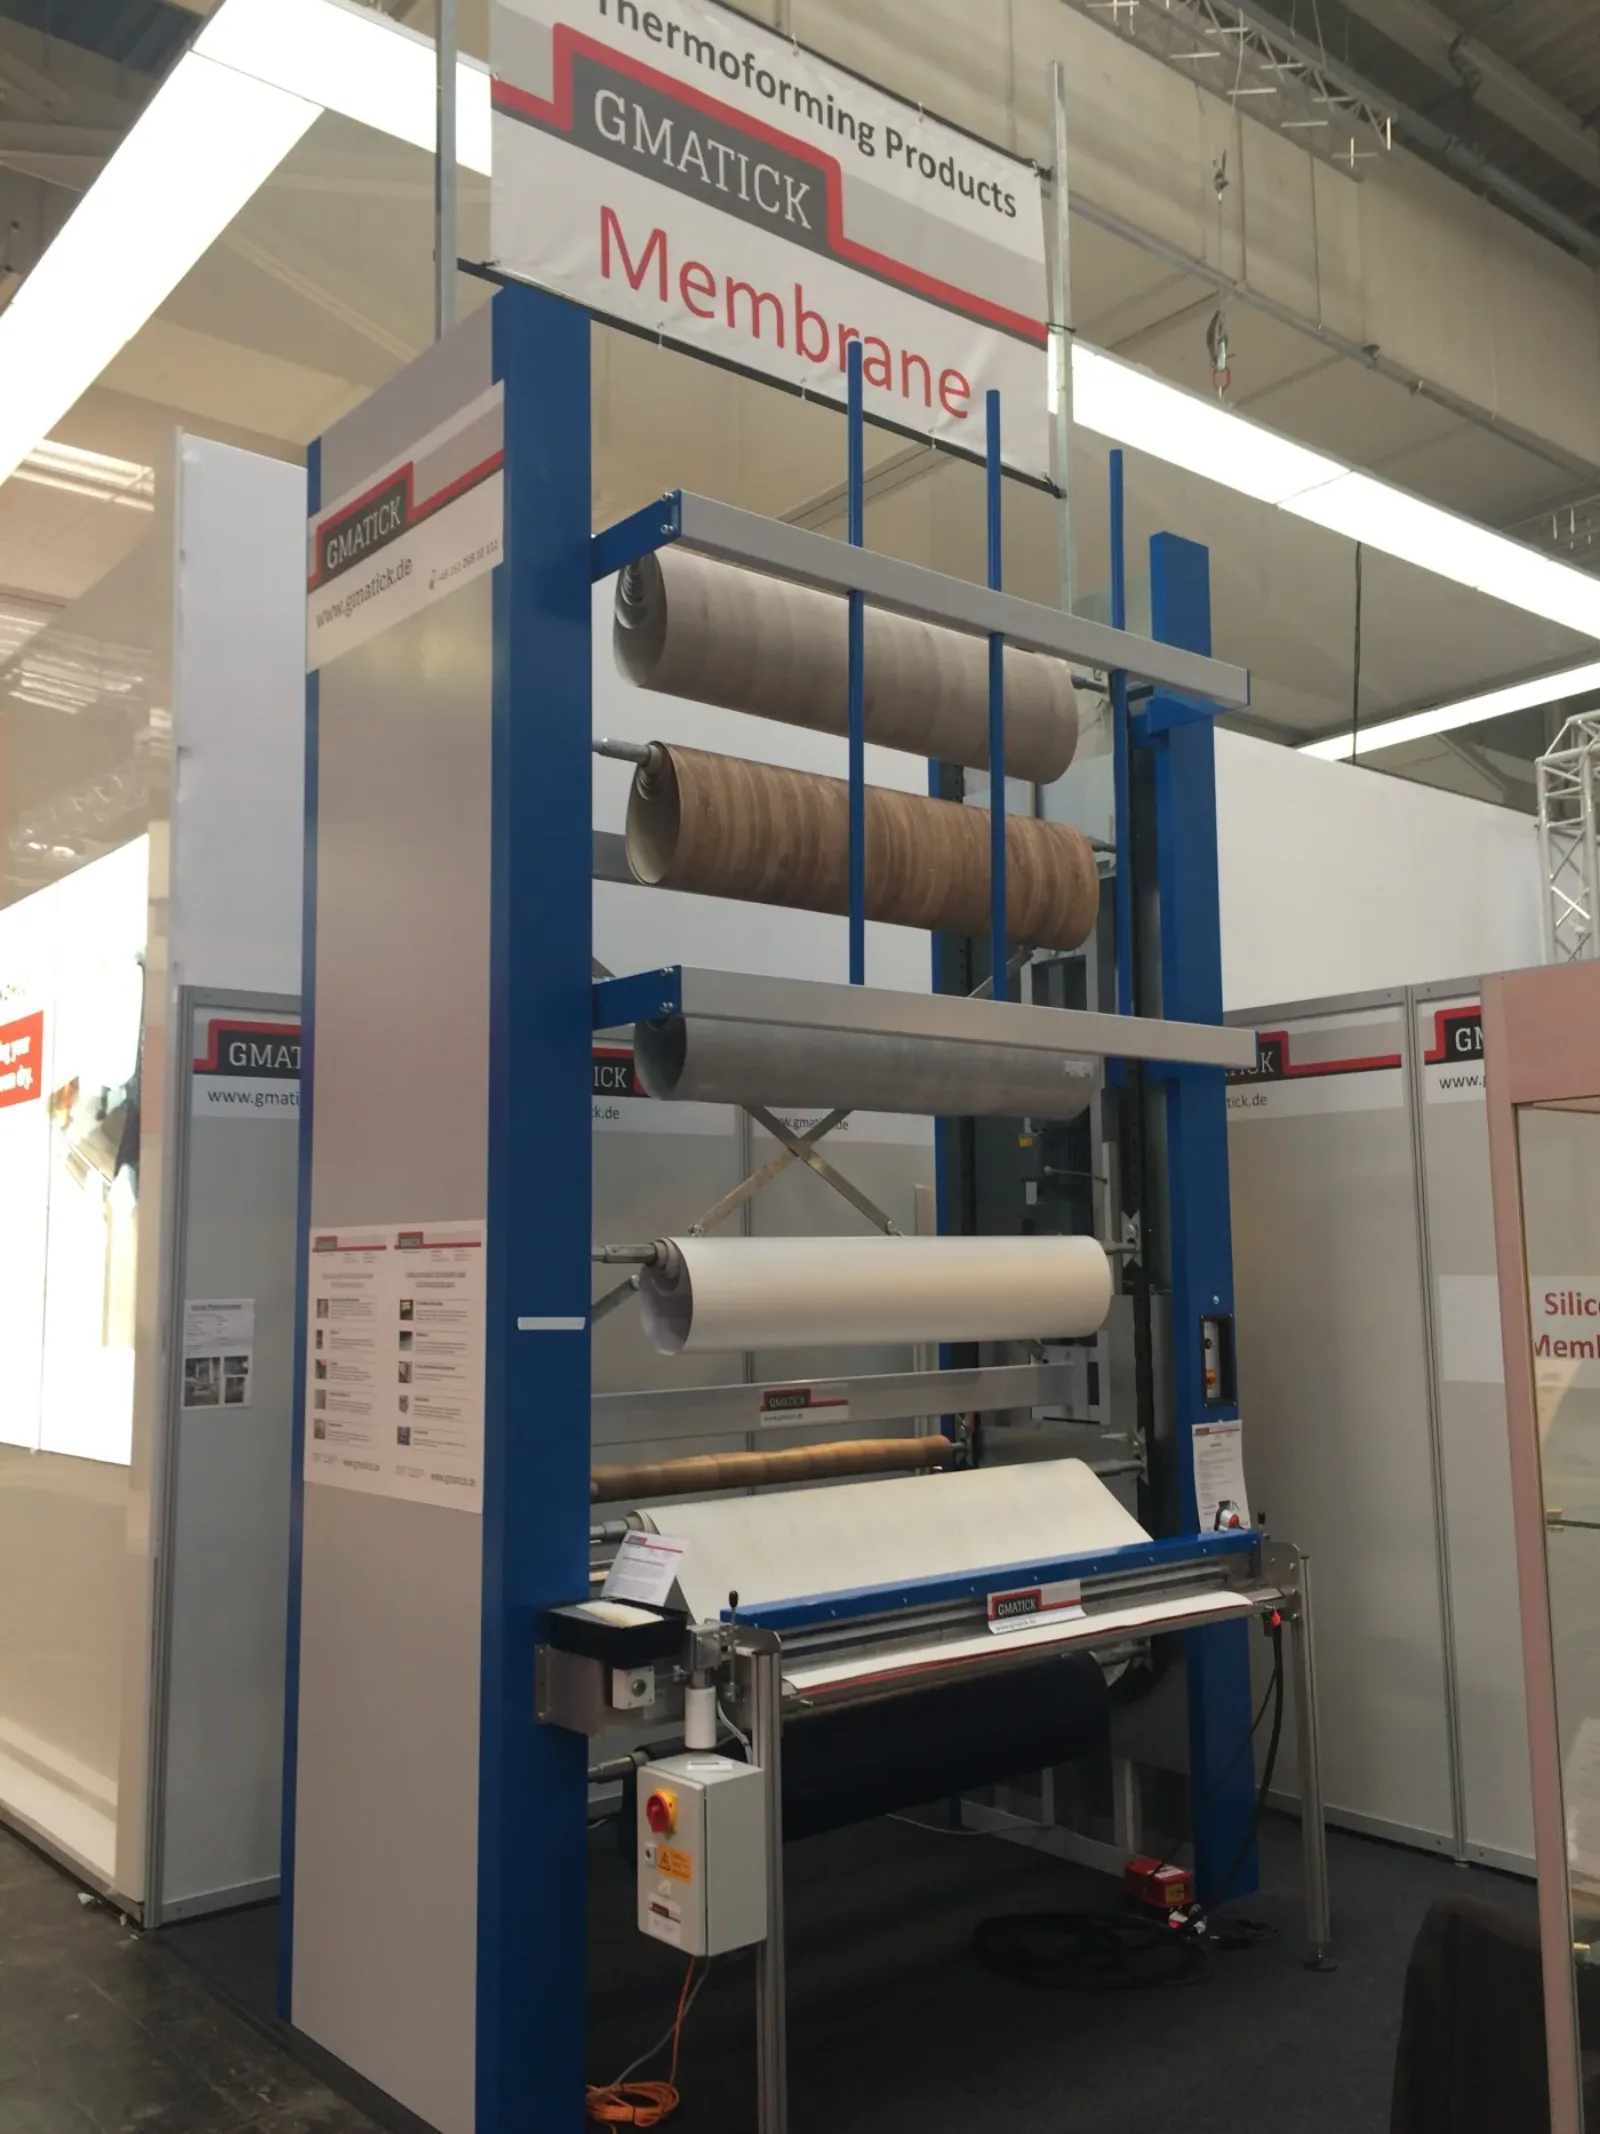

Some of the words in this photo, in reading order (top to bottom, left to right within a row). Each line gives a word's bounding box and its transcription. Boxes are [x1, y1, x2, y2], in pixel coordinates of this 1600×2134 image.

[594, 89, 812, 230] GMATICK
[885, 127, 1017, 218] Products
[600, 206, 971, 419] Membrane
[326, 496, 401, 569] GMATICK
[315, 557, 413, 628] www.gmatick.de
[229, 1042, 301, 1069] GMAT
[593, 1066, 627, 1088] ICK
[1544, 1291, 1600, 1316] Silic
[998, 1598, 1037, 1616] GMATICK
